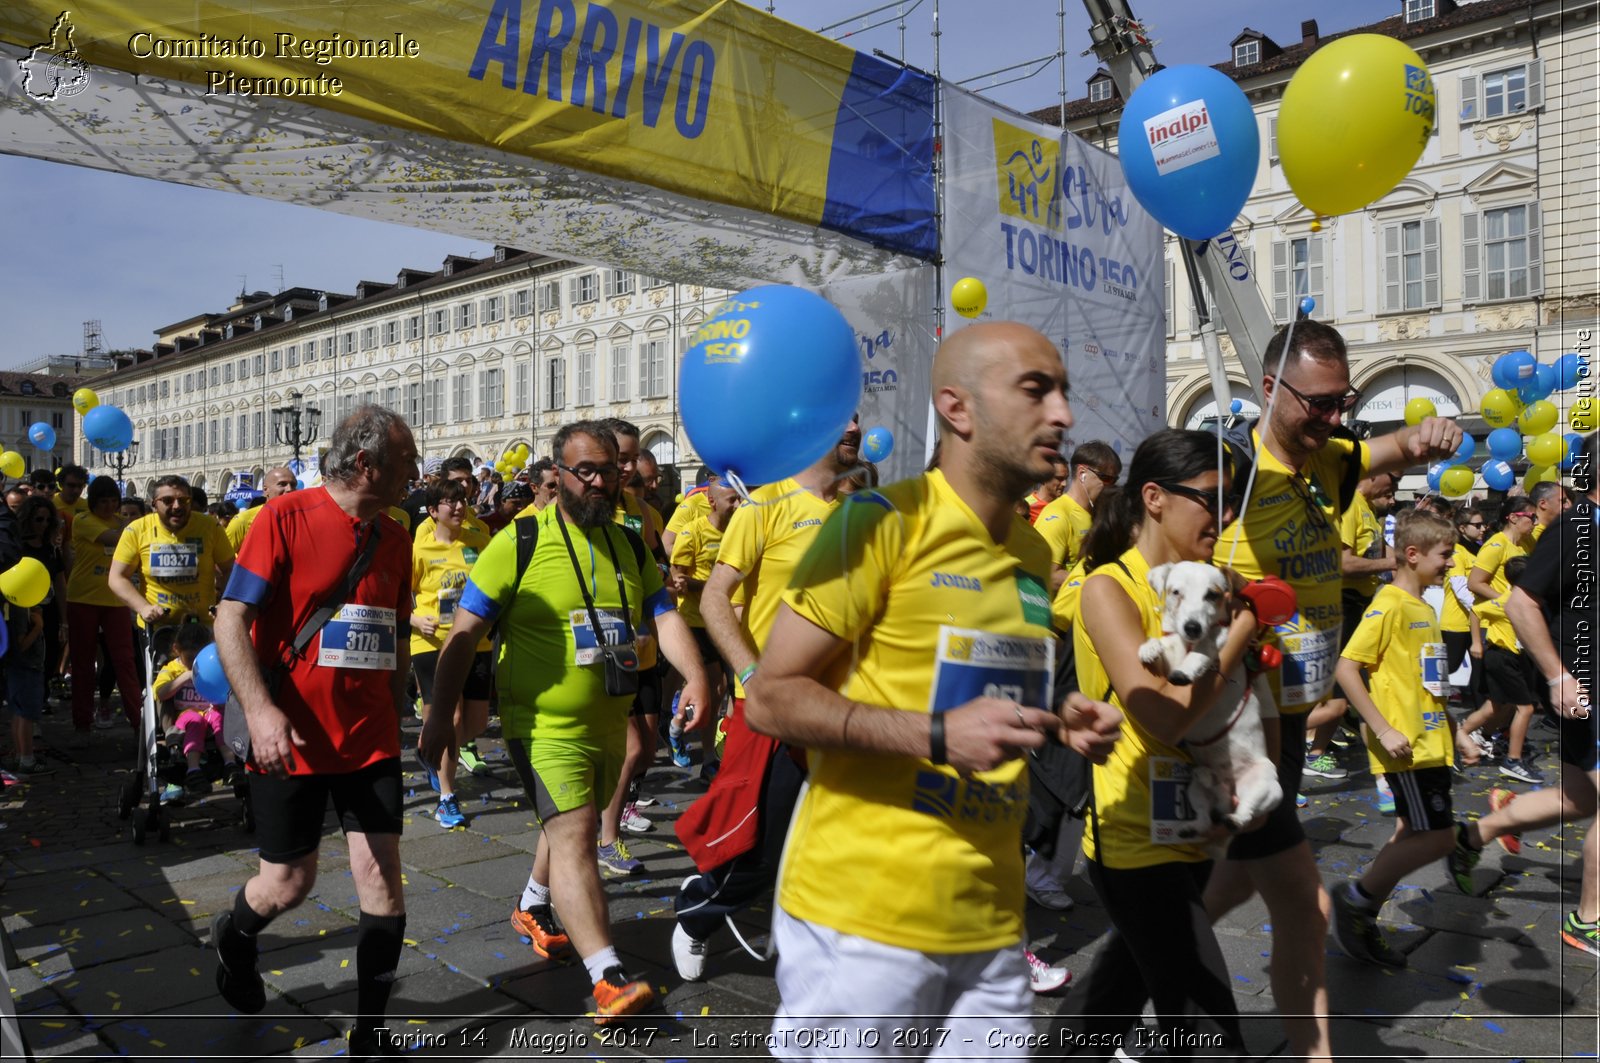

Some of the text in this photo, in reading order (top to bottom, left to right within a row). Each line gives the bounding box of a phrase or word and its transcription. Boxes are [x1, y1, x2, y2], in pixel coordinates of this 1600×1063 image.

[467, 0, 716, 139] ARRIVO
[1149, 107, 1208, 145] inalpi
[1000, 221, 1137, 292] TORINO 150
[863, 369, 898, 386] 150
[158, 553, 190, 567] 10327
[1276, 549, 1338, 580] TORINO
[357, 608, 384, 620] TORINO
[349, 623, 369, 631] ANGELO
[346, 630, 381, 652] 3178
